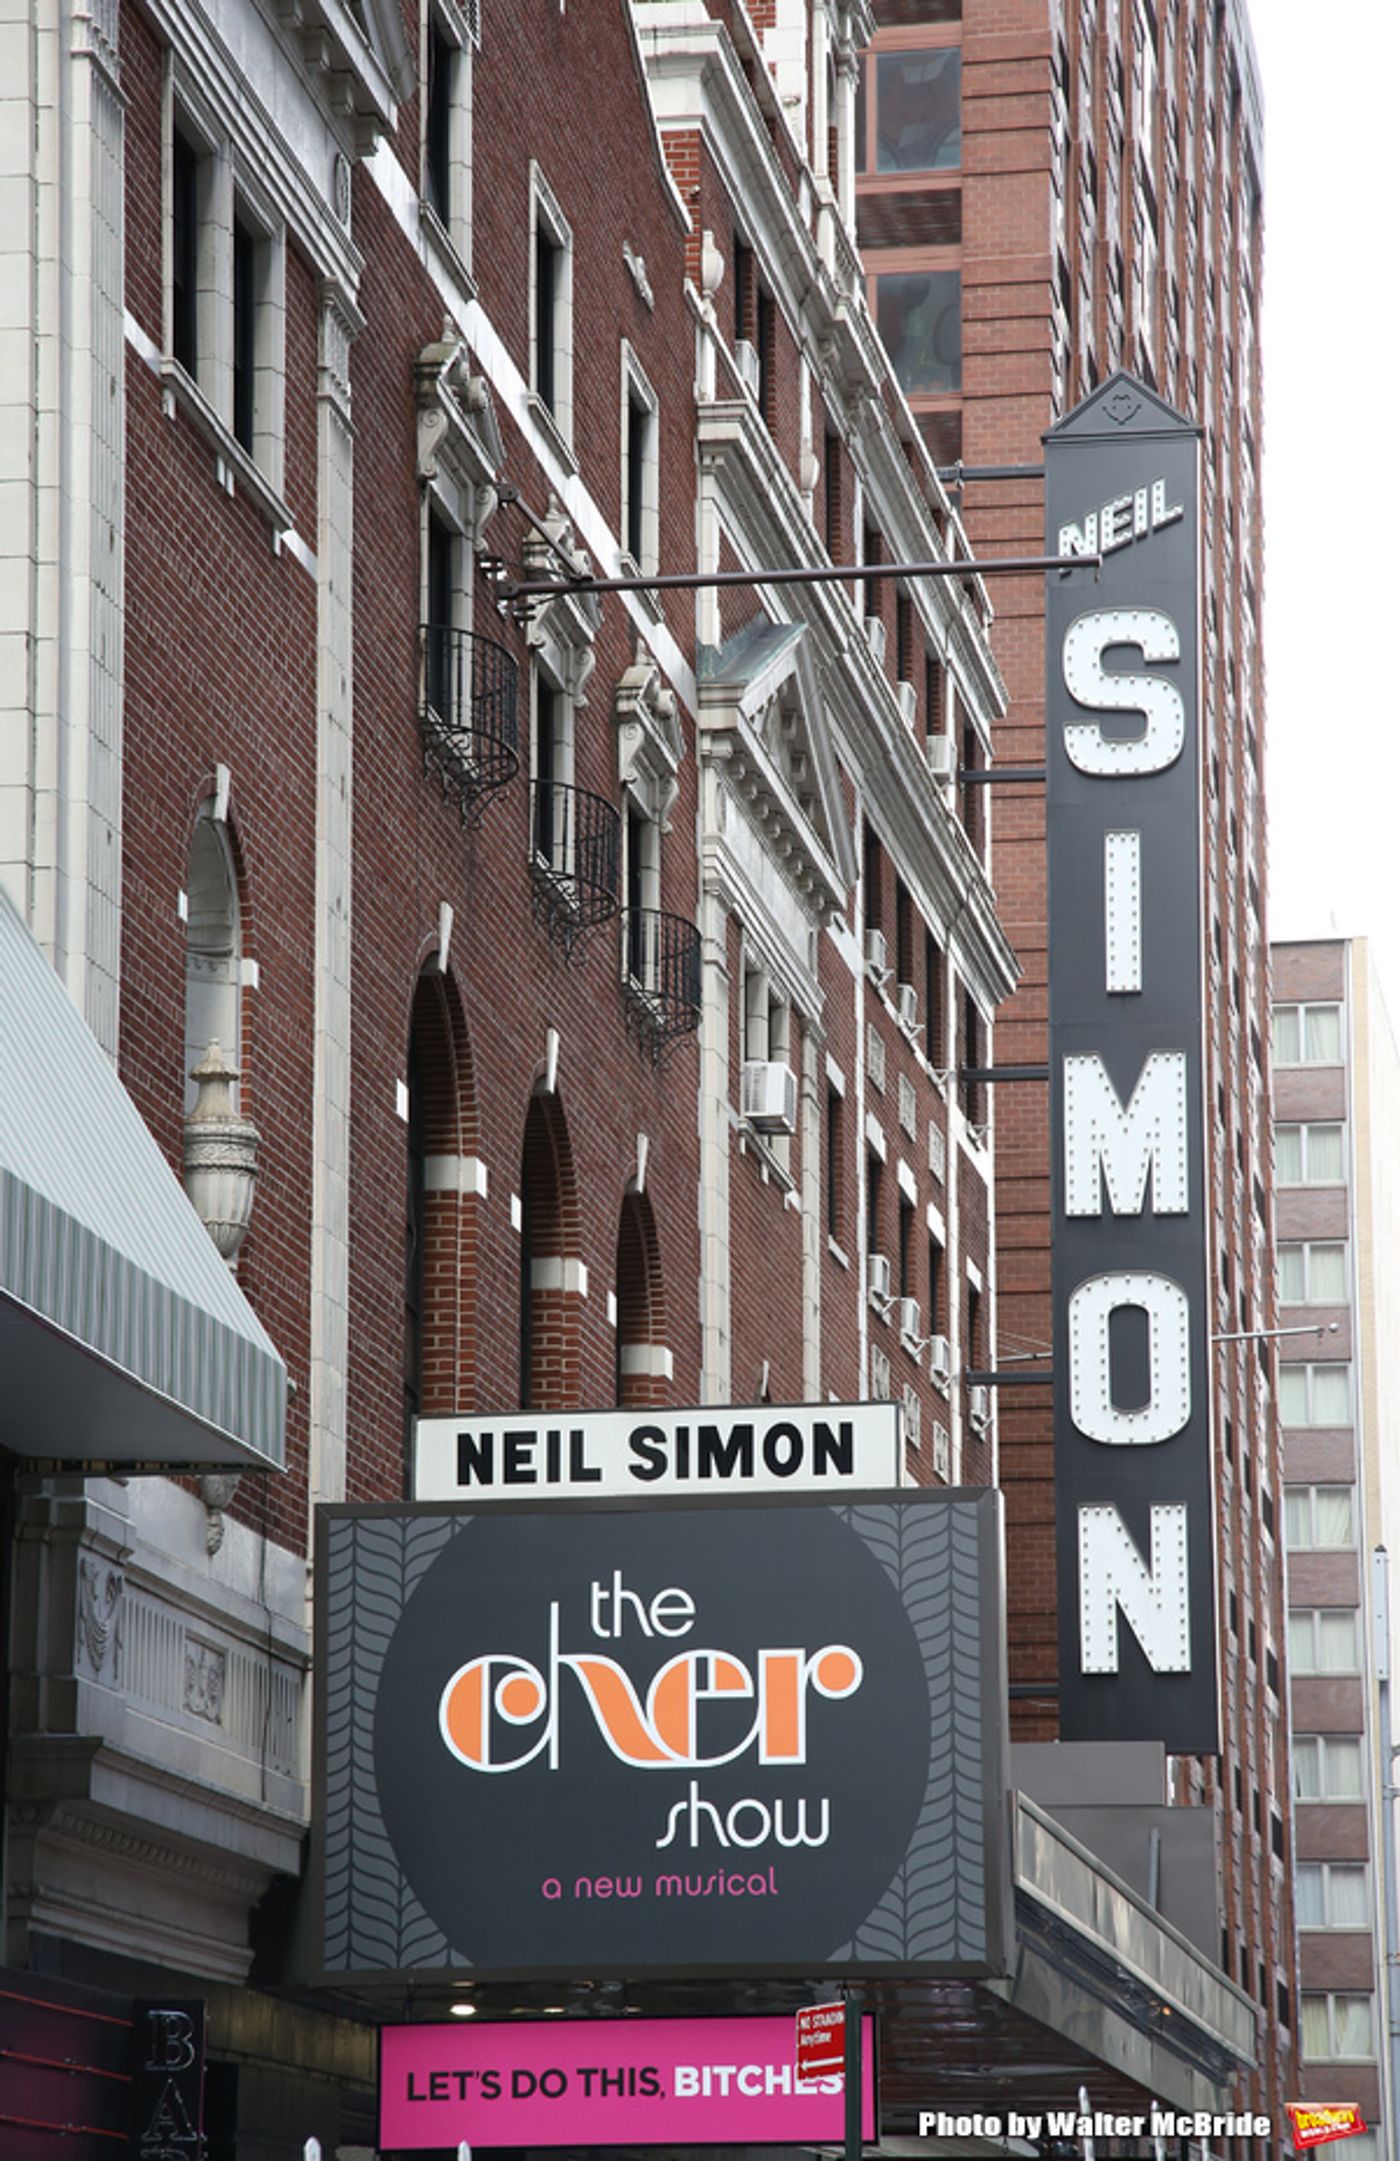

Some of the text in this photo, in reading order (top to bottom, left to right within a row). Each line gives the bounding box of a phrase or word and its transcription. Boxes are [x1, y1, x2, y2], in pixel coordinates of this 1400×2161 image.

[1058, 478, 1184, 578] NEIL
[1062, 607, 1192, 1674] SIMON
[456, 1421, 854, 1486] NEIL SIMON
[590, 1570, 696, 1638] the
[438, 1602, 864, 1773] cher
[655, 1780, 830, 1849] show
[541, 1866, 779, 1900] a new musical
[406, 2070, 502, 2101] LET'S
[511, 2068, 568, 2099] DO
[577, 2066, 666, 2099] THIS,
